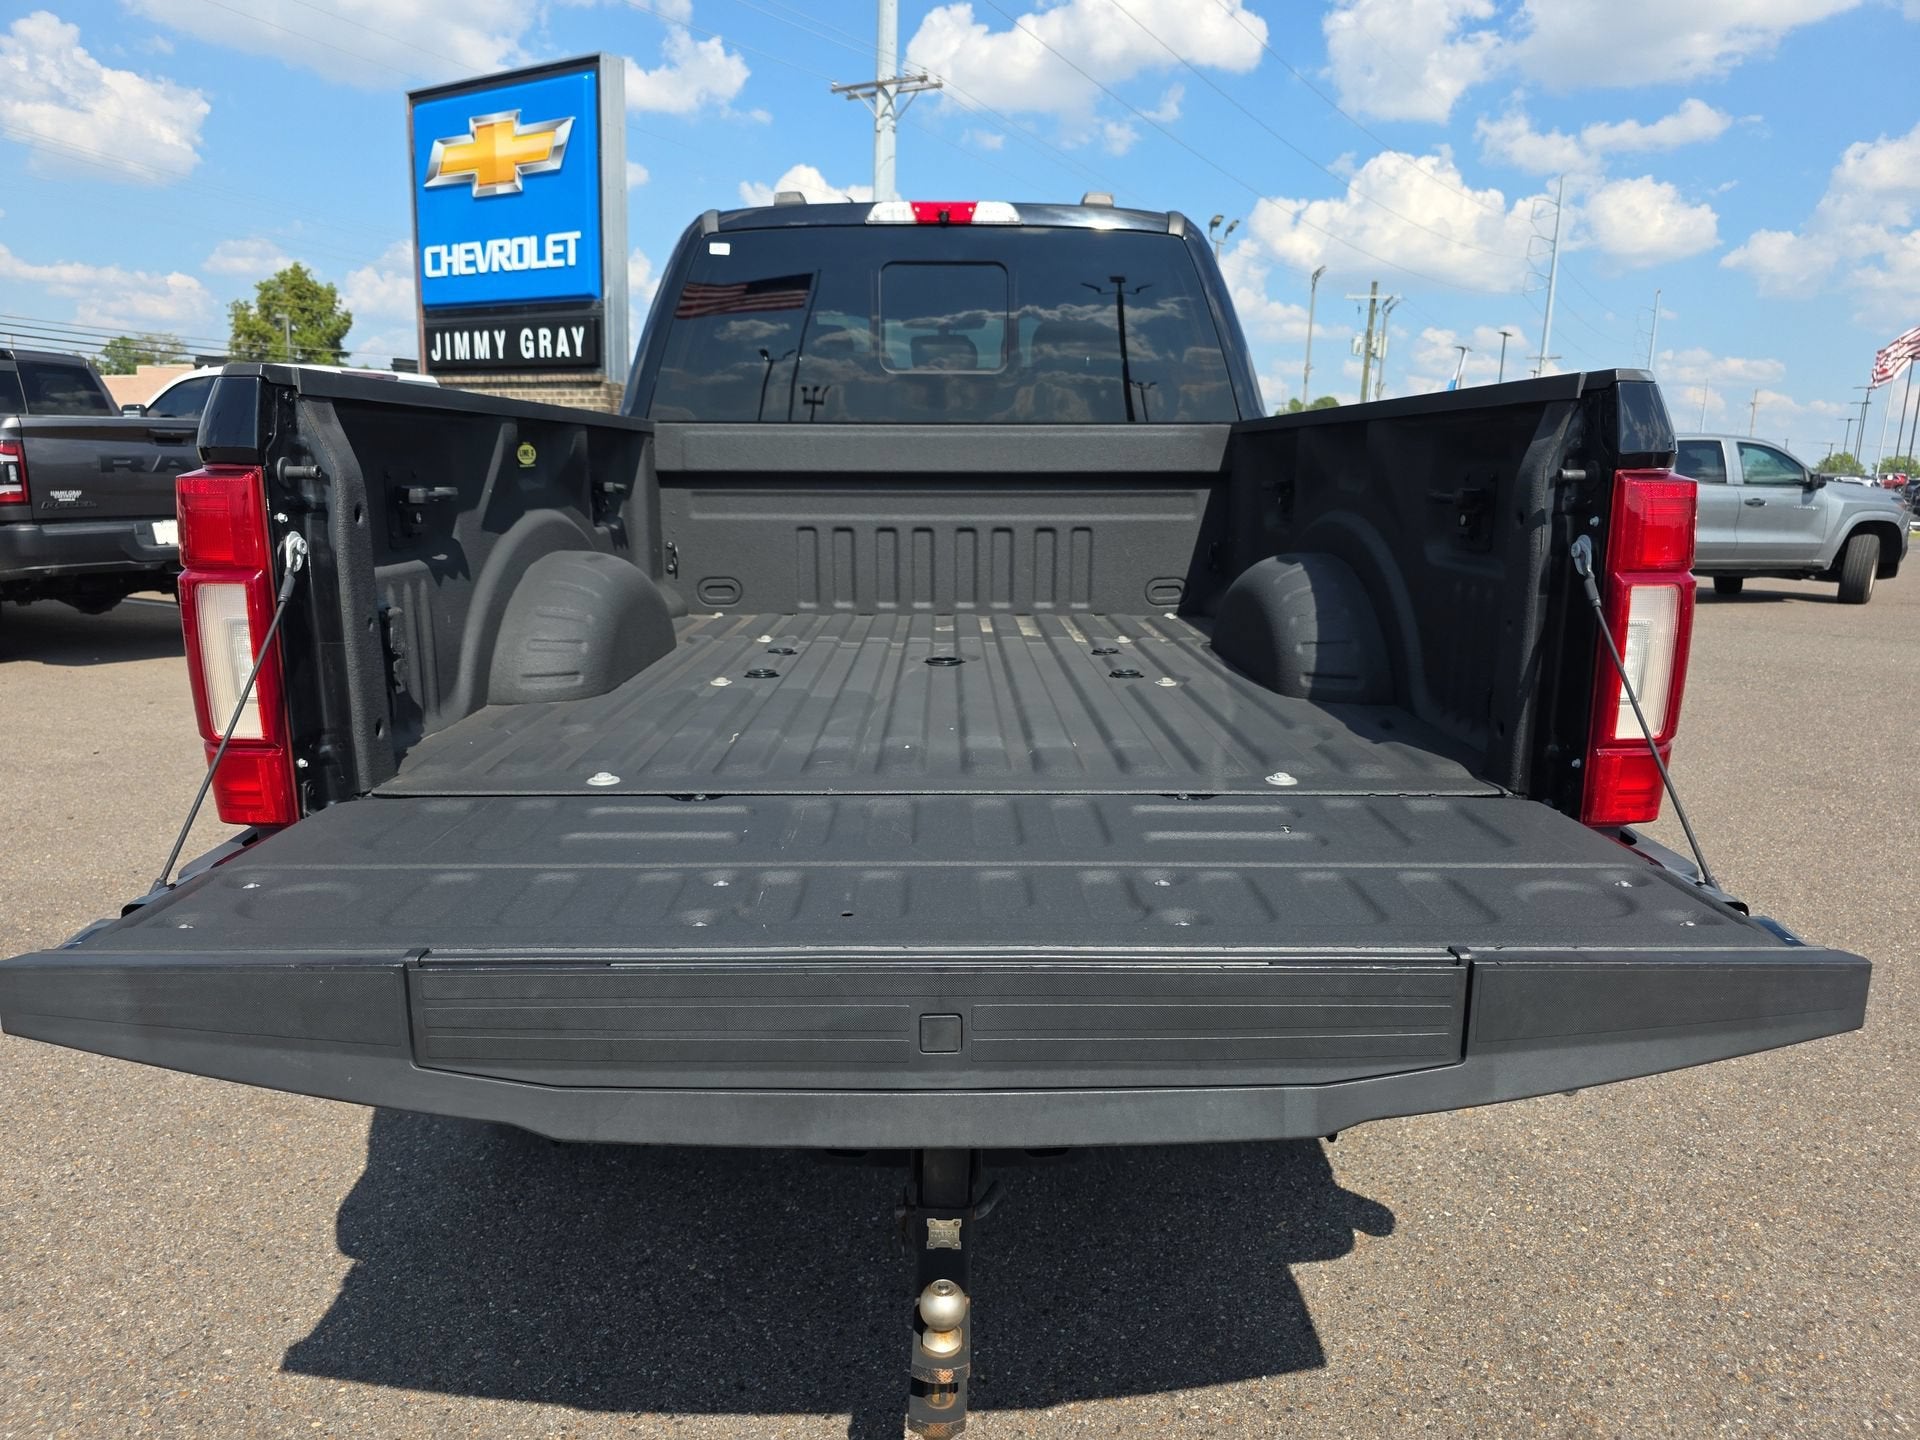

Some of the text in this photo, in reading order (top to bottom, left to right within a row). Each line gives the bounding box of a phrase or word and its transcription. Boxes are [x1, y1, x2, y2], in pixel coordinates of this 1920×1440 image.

[424, 230, 582, 278] CHEVROLET
[430, 325, 585, 361] JIMMY GRAY
[101, 456, 193, 473] RA
